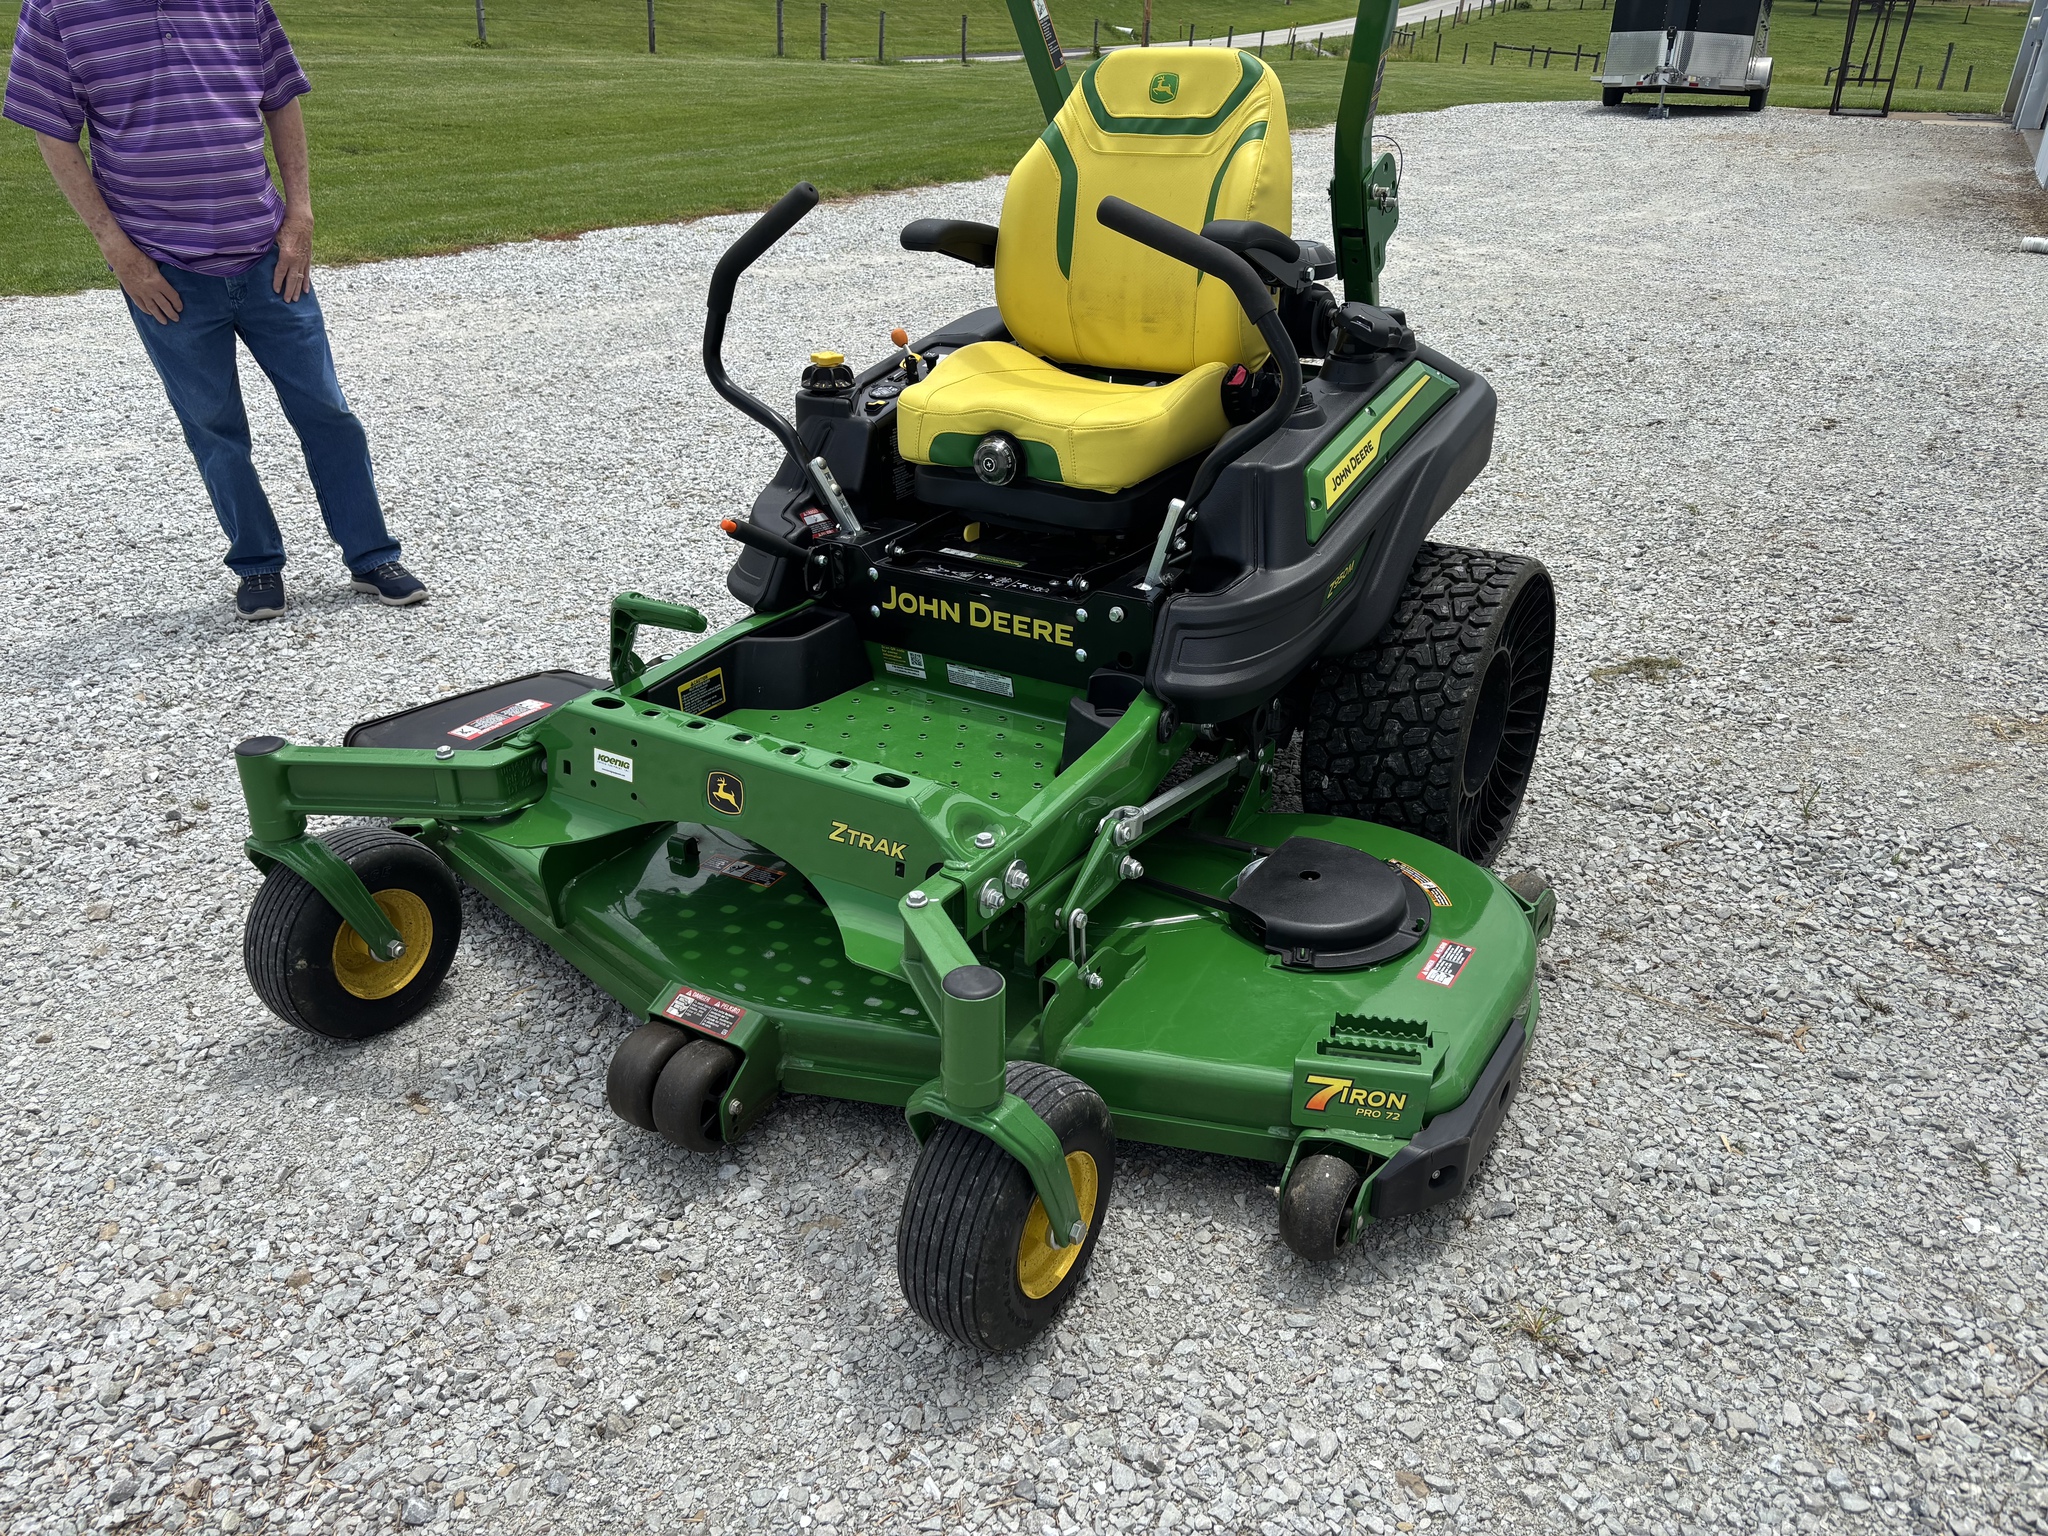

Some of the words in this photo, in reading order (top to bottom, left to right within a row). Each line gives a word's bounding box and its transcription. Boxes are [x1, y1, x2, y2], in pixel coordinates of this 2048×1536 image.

[1332, 464, 1352, 492] JOHN
[1349, 440, 1374, 470] DEERE
[881, 585, 961, 624] JOHN
[969, 601, 1074, 647] DEERE
[828, 820, 908, 861] ZTRAK
[692, 990, 711, 1003] DANGER
[720, 1002, 741, 1015] PELIGRO
[1355, 1107, 1381, 1118] PRO
[1385, 1111, 1401, 1121] 72
